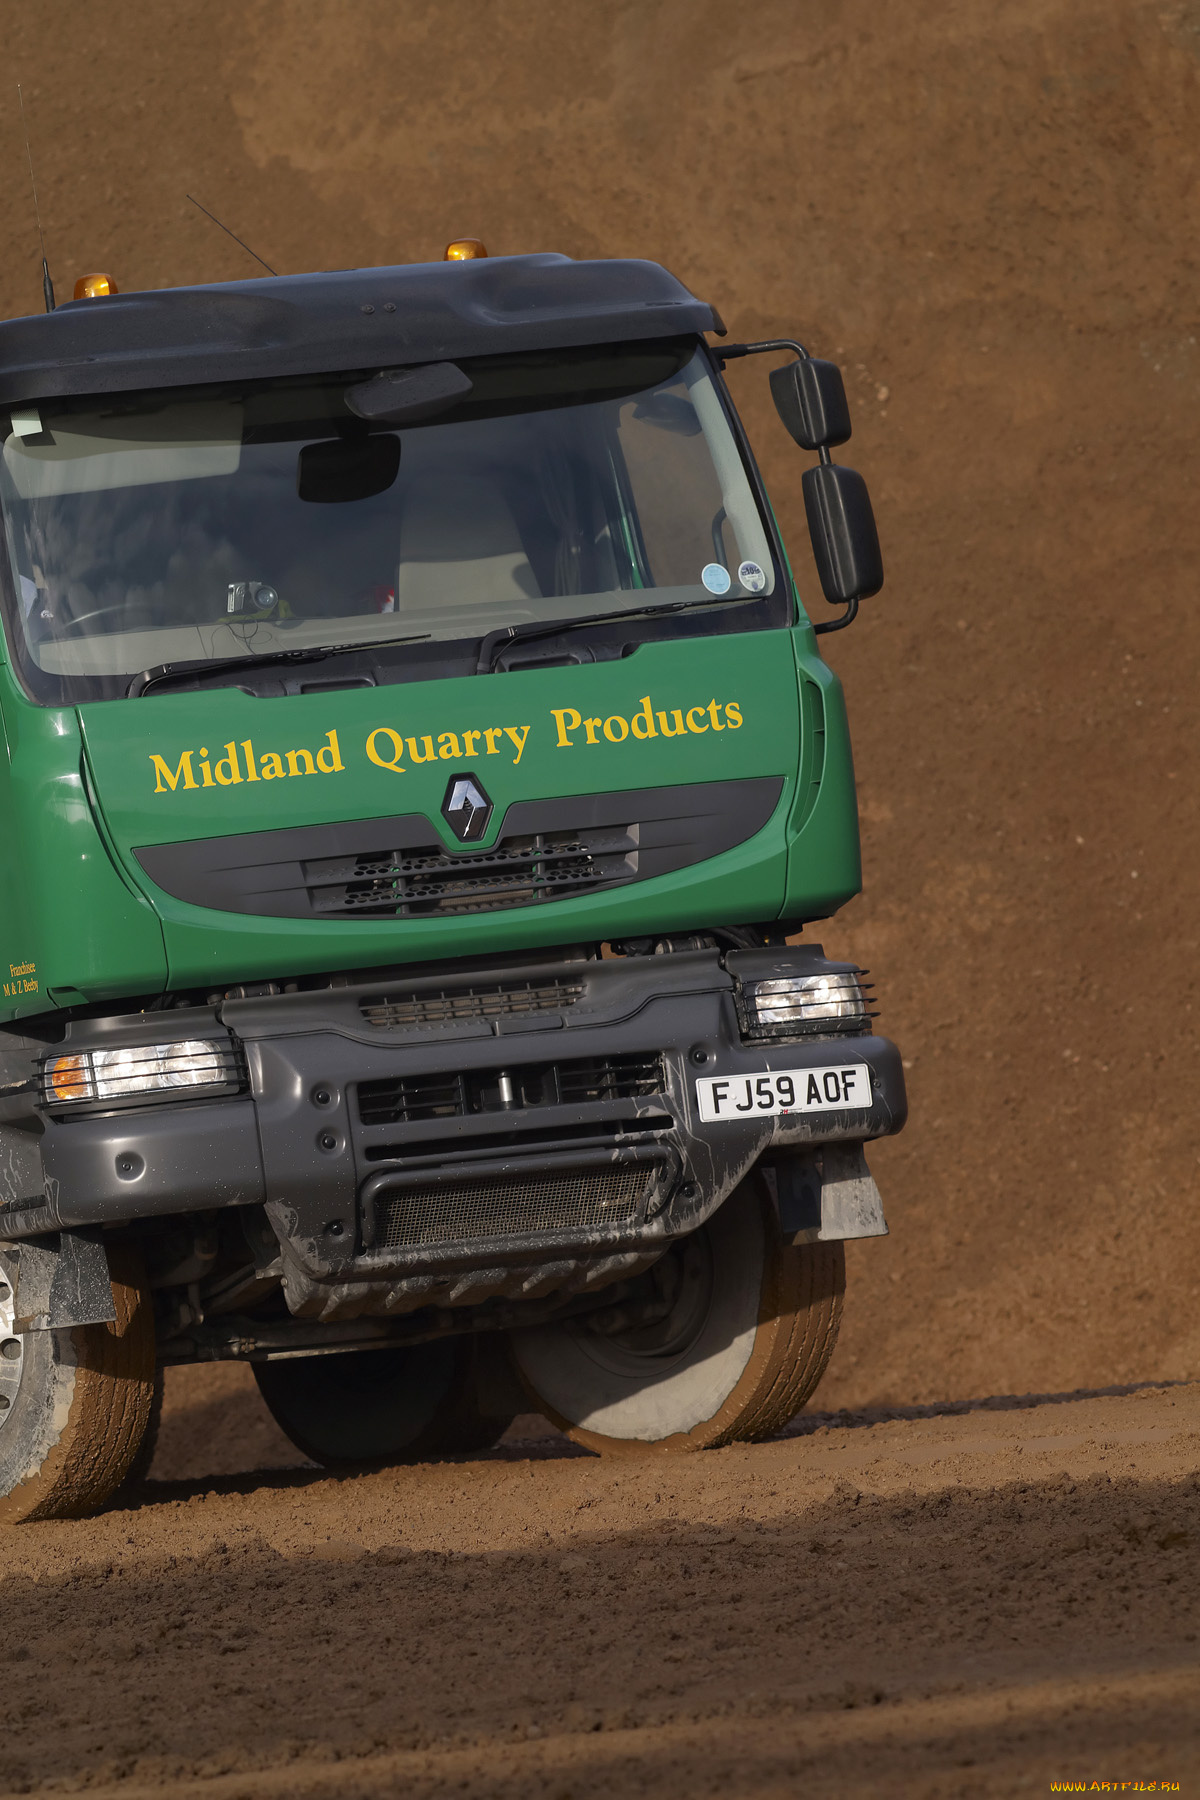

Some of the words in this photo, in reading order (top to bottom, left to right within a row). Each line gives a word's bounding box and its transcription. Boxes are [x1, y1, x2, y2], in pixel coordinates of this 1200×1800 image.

[148, 729, 345, 793] Midland
[365, 726, 531, 773] Quarry
[550, 695, 744, 748] Products
[2, 983, 11, 997] M
[11, 982, 17, 995] &
[17, 980, 23, 994] Z
[711, 1076, 796, 1114] FJ59
[806, 1069, 857, 1105] AOF
